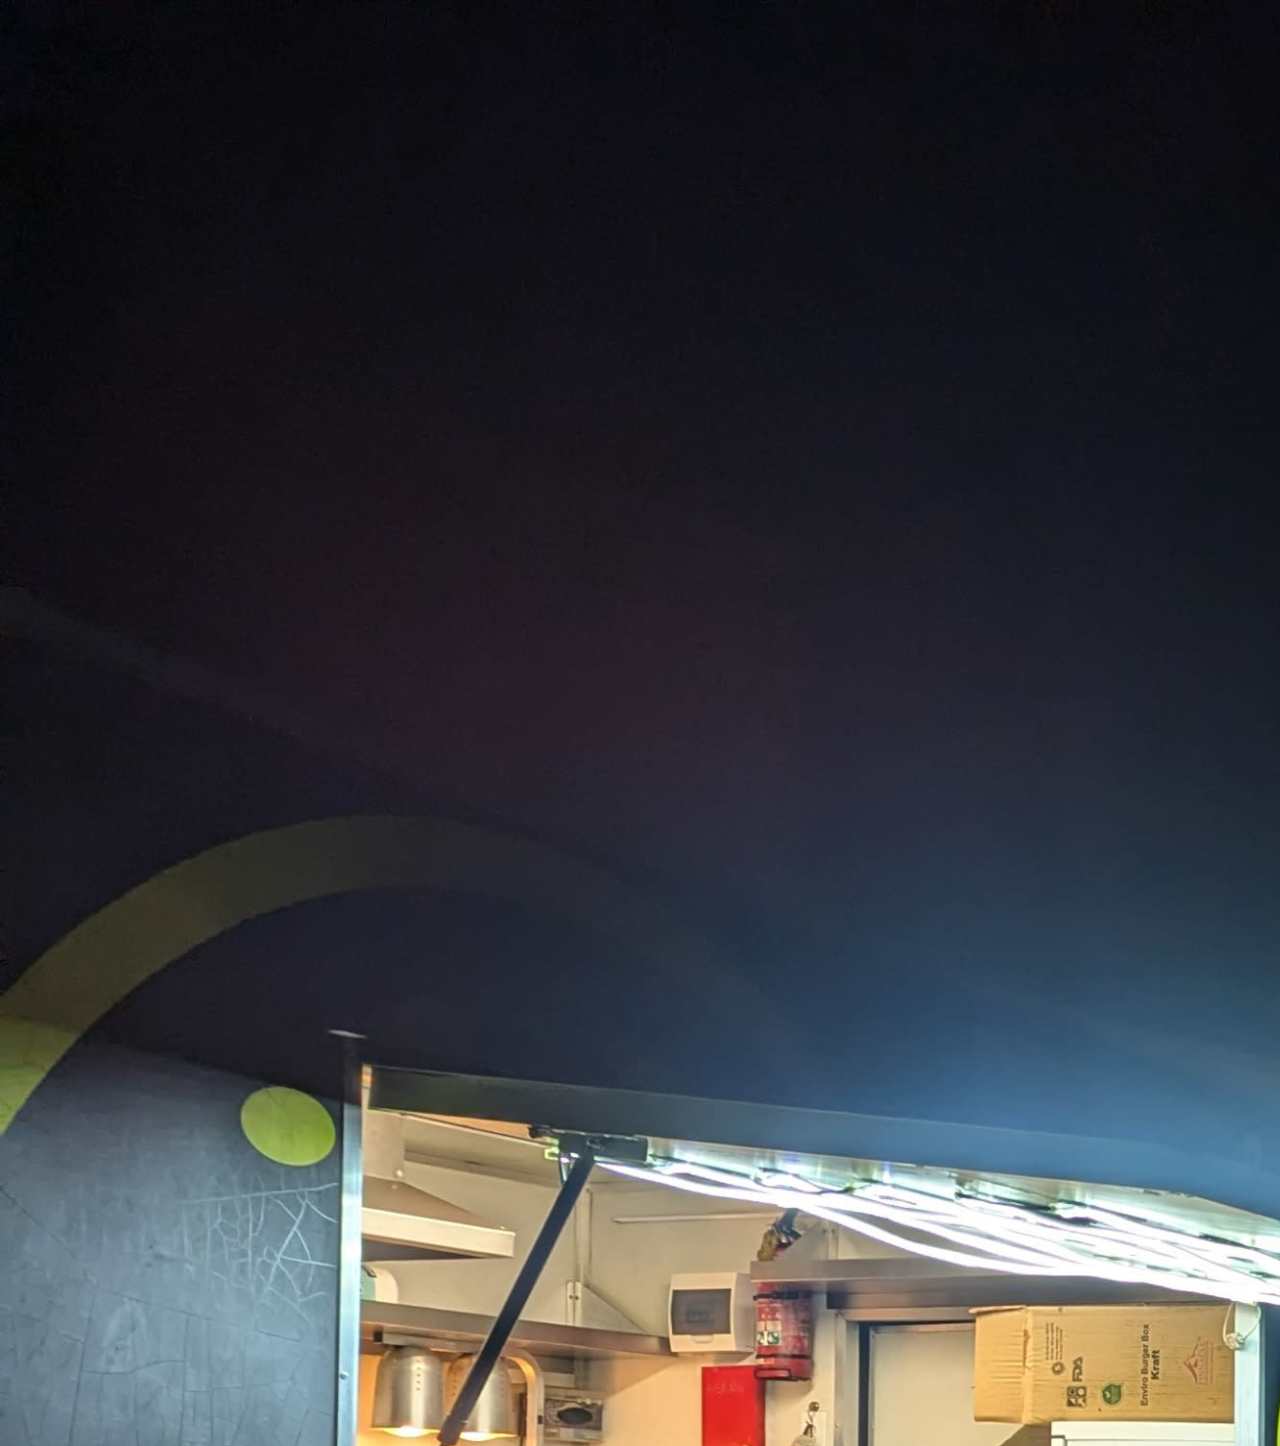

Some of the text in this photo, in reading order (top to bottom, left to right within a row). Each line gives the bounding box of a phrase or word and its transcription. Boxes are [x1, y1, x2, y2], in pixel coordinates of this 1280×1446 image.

[1140, 1324, 1150, 1406] Enviro Burger Box
[1151, 1350, 1160, 1380] Kraft
